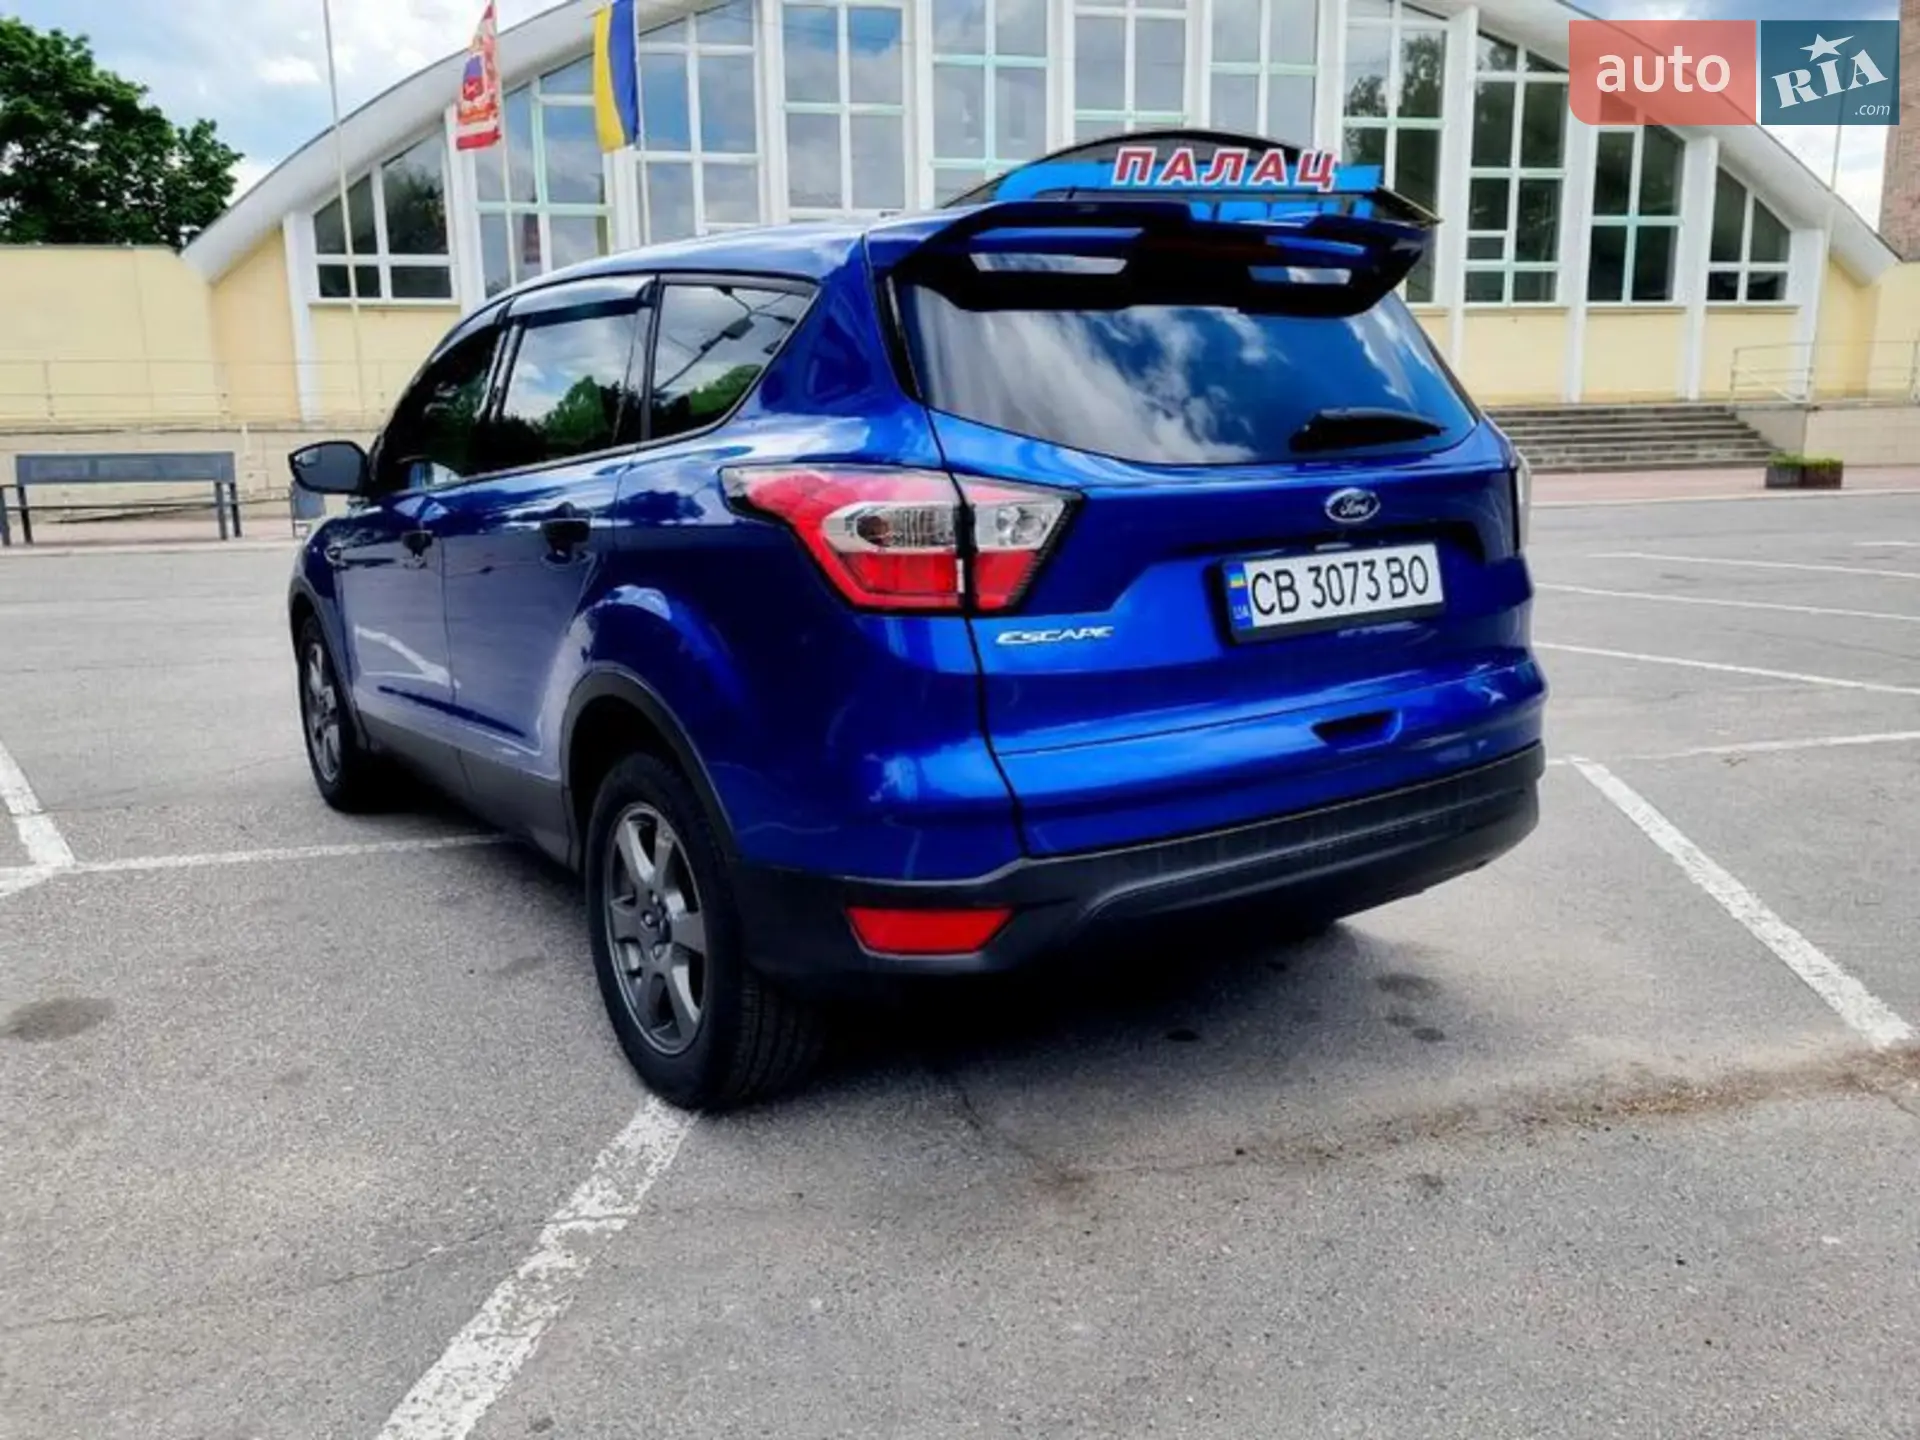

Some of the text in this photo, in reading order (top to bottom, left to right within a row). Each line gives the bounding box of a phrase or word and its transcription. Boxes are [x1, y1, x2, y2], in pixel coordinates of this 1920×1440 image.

[1112, 147, 1336, 193] ПАЛАЦ
[1251, 554, 1430, 617] CB 3073 BO
